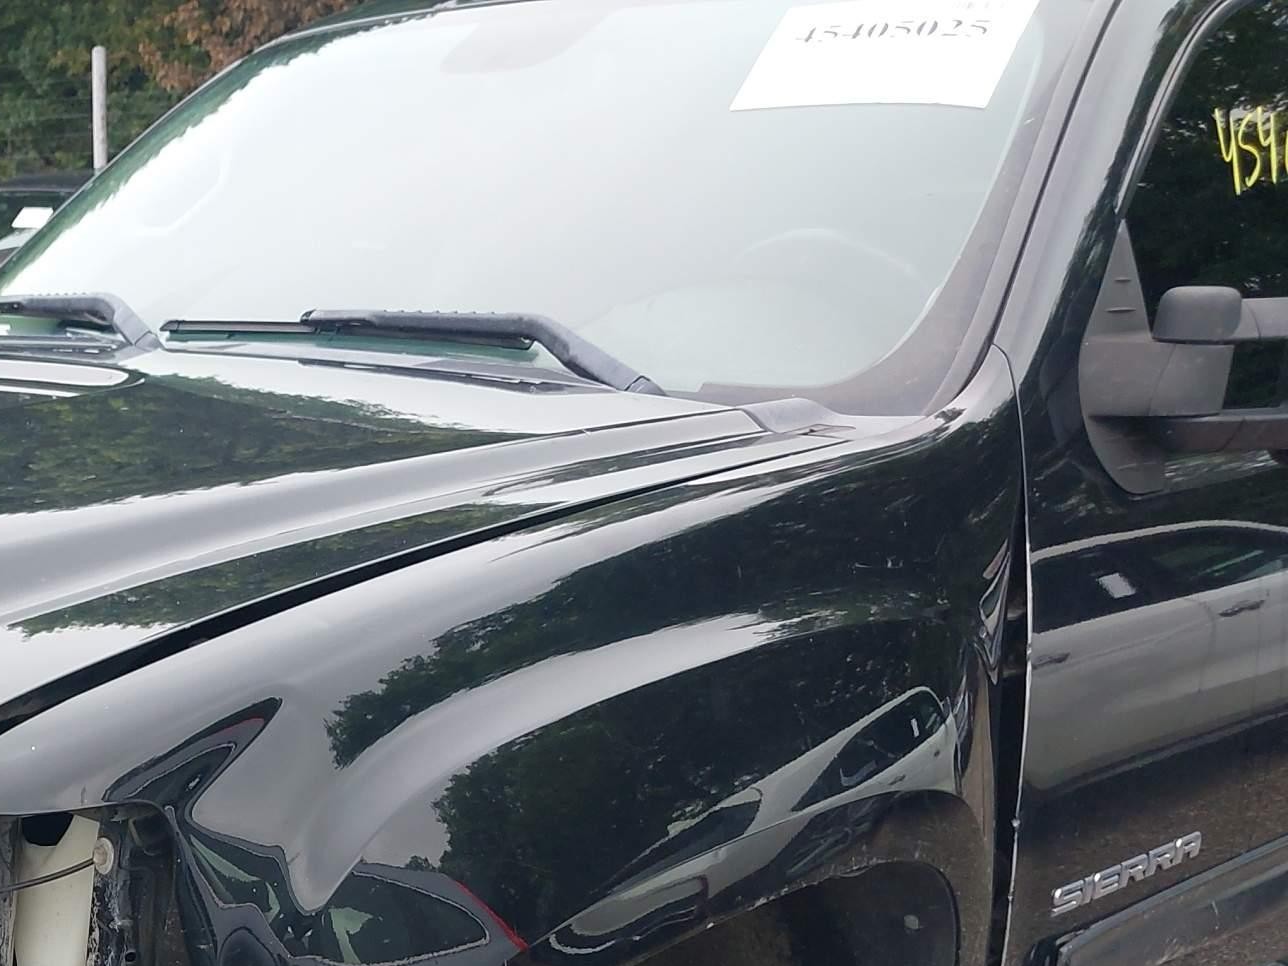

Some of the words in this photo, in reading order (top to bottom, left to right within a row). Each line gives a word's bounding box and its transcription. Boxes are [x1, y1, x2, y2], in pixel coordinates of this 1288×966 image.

[795, 18, 993, 44] 45405025
[1211, 105, 1288, 196] 454
[1050, 831, 1203, 918] SIERRA
